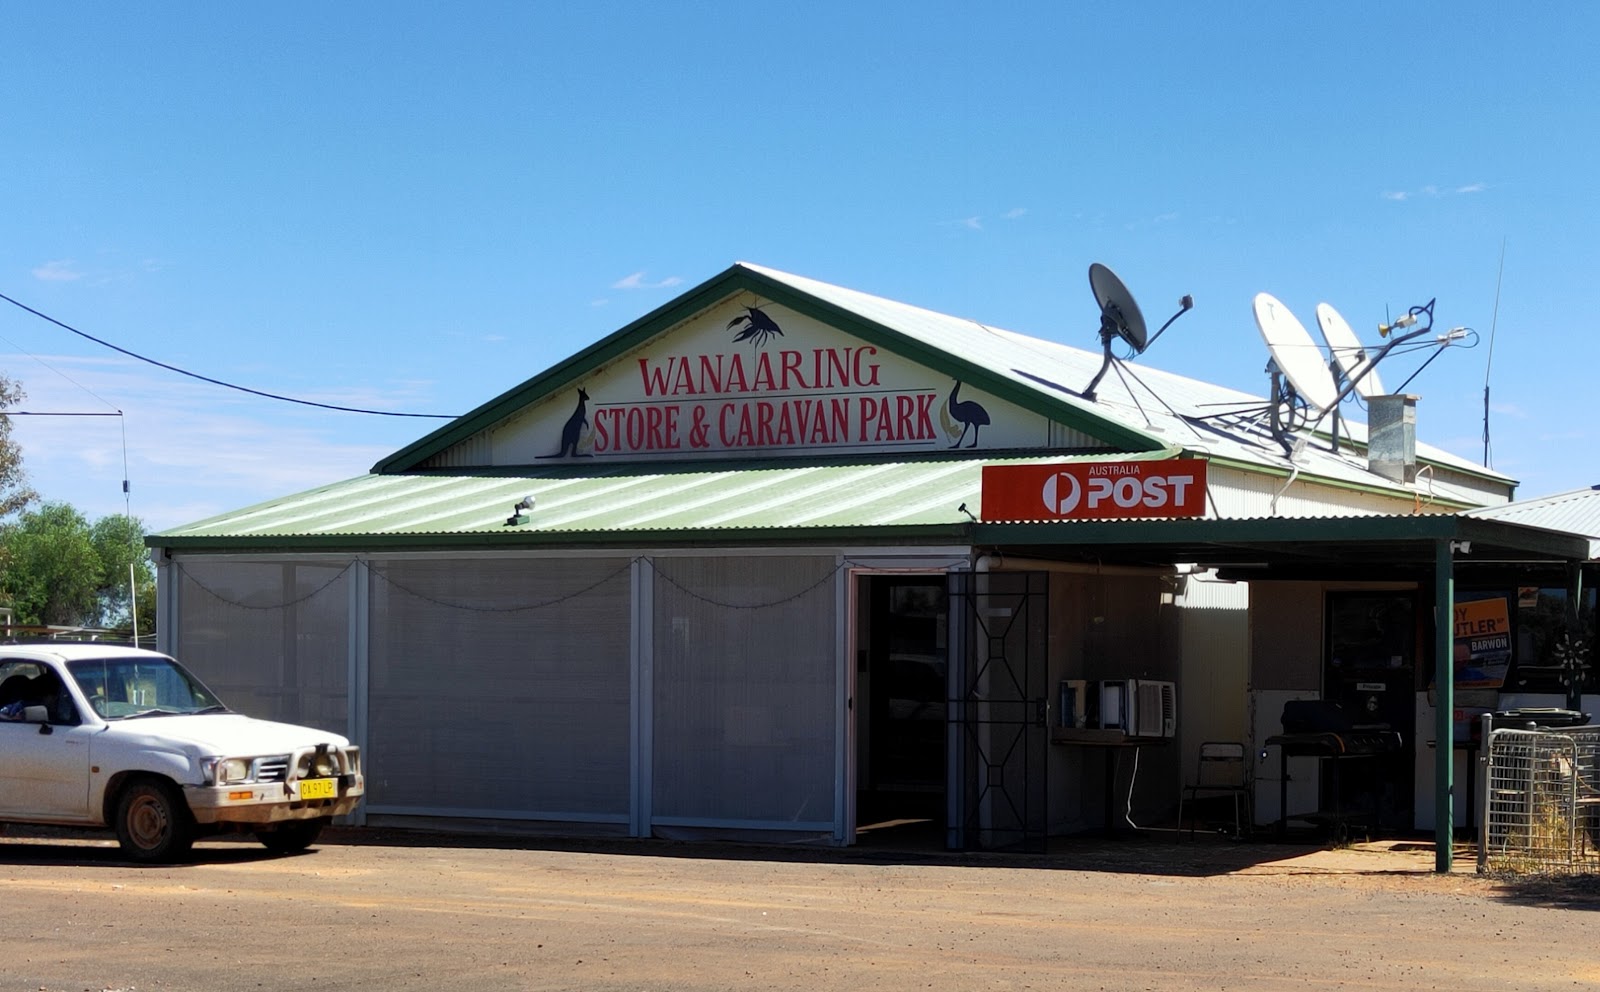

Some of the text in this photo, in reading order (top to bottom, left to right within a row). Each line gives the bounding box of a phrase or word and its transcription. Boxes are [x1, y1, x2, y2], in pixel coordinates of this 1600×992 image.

[638, 346, 881, 397] WANAARING
[594, 394, 937, 453] STORE & CARAVAN PARK
[1089, 465, 1141, 476] AUSTRALIA
[1088, 475, 1194, 509] POST
[1471, 637, 1508, 652] BARWON
